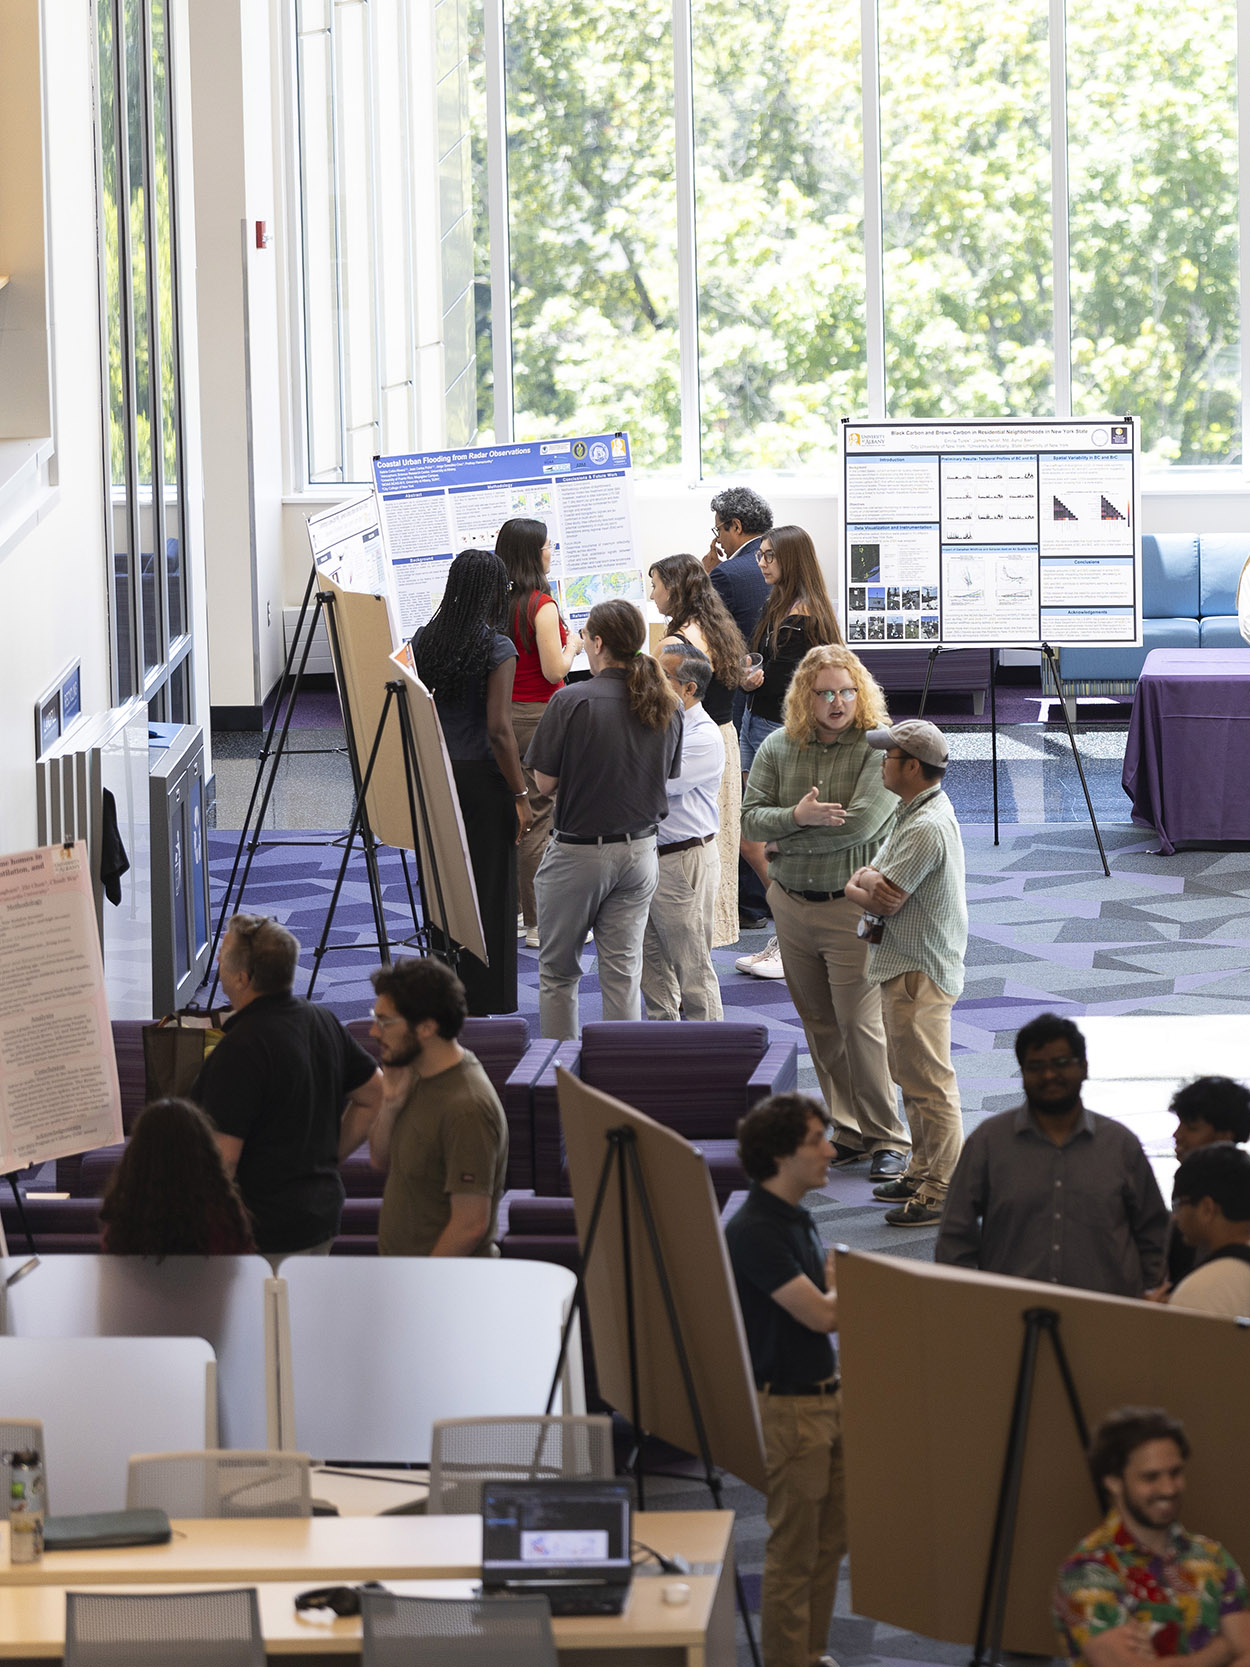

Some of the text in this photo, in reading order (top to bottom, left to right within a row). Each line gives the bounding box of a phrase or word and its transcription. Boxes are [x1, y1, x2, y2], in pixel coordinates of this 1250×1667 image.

[377, 459, 401, 468] Coastal
[402, 457, 422, 466] Urban
[423, 455, 451, 464] Flooding
[469, 451, 488, 460] Radar
[489, 447, 531, 458] Observations
[11, 856, 33, 865] homes
[32, 862, 45, 871] and
[7, 899, 42, 911] Methodology
[31, 1013, 54, 1023] Analysis
[34, 1064, 66, 1076] Conclusion
